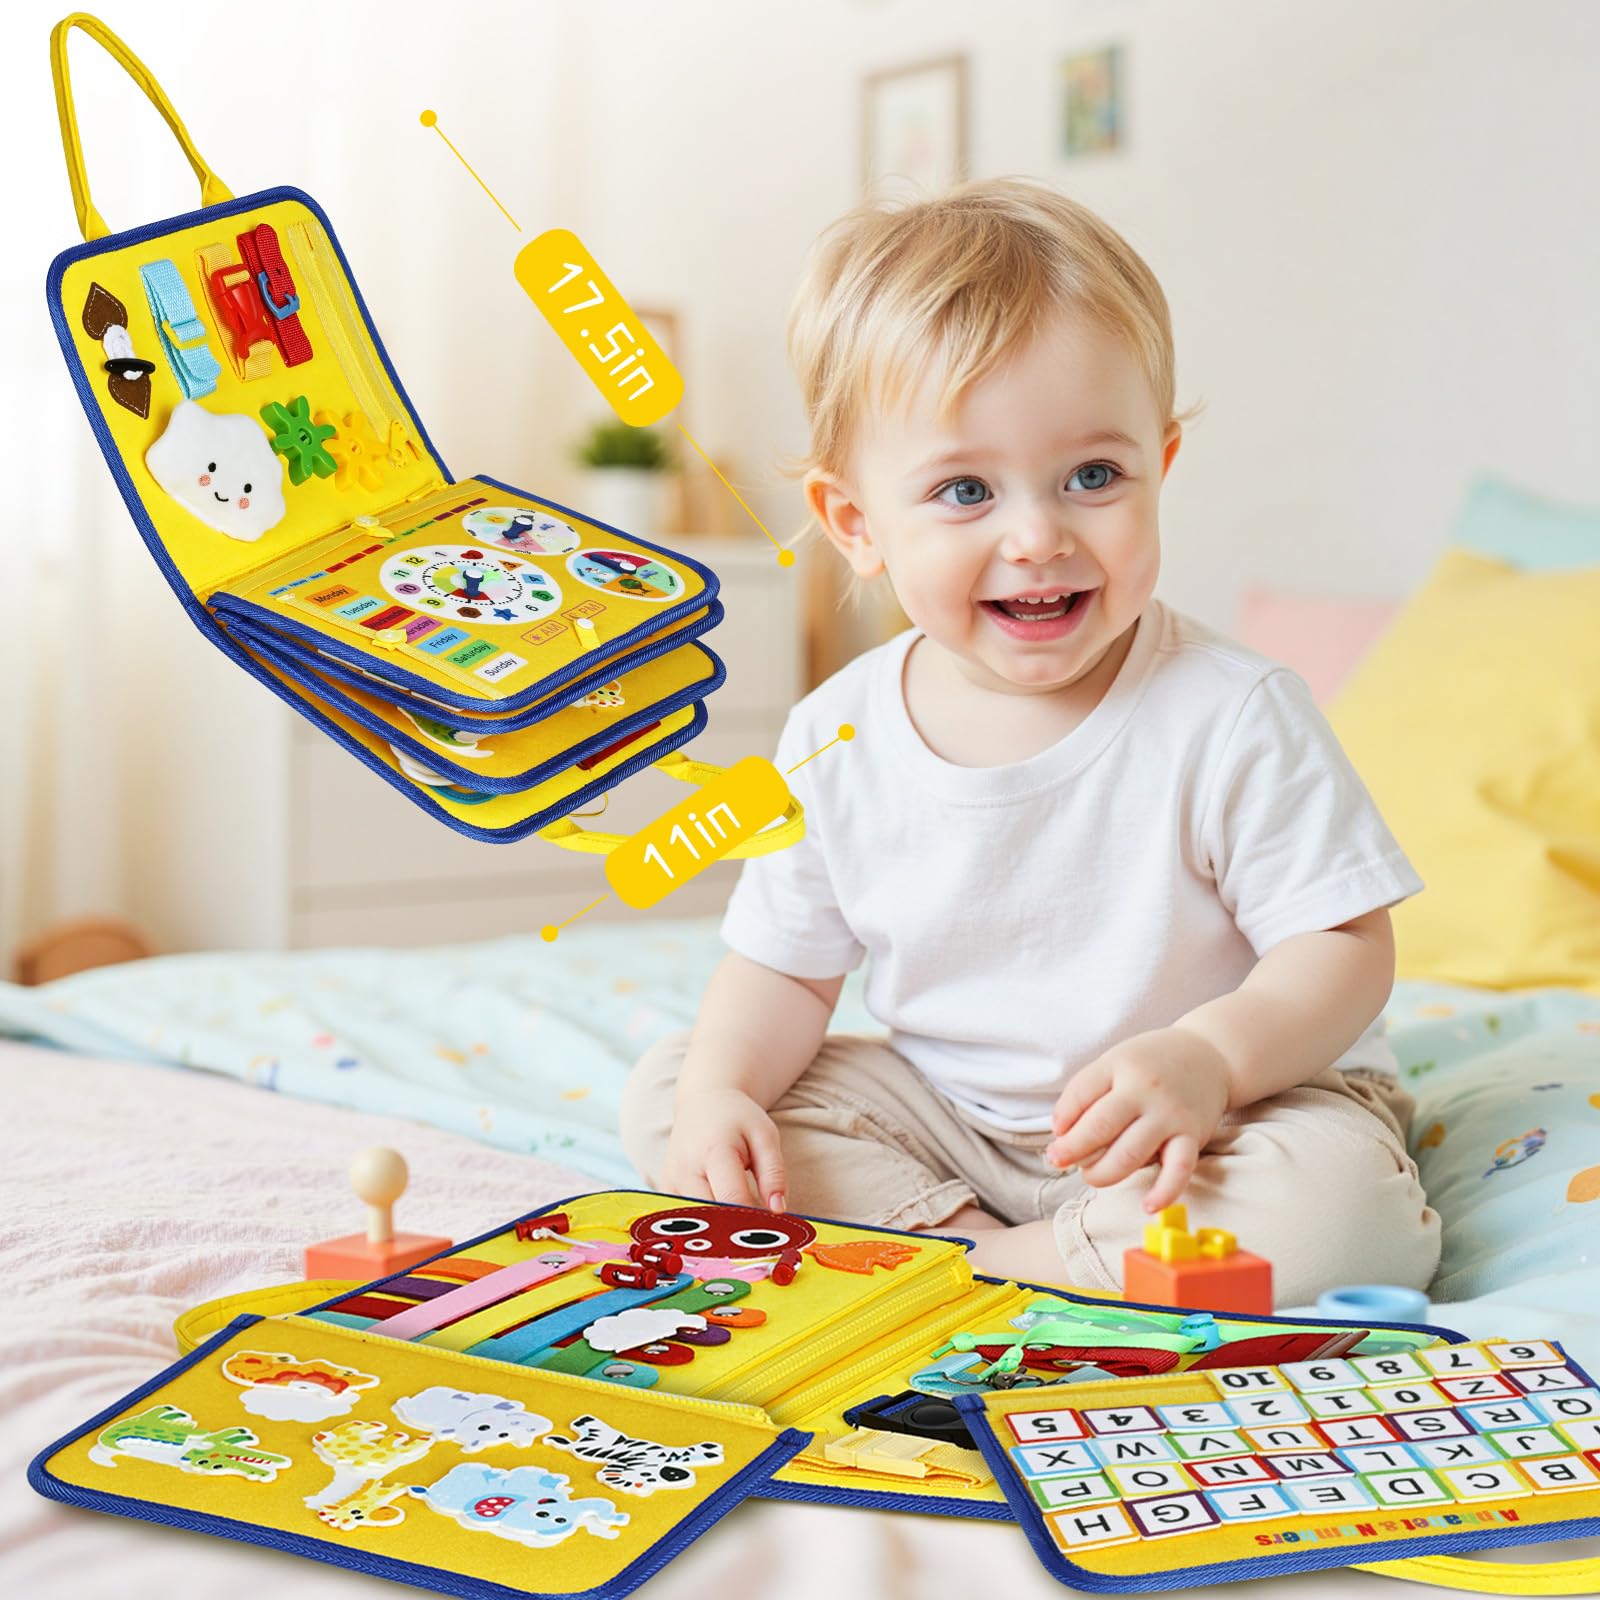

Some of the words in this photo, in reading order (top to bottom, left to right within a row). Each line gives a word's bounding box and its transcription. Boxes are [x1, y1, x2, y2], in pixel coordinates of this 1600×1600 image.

[406, 556, 424, 565] 12
[394, 570, 410, 578] 11
[313, 588, 349, 604] Monday
[400, 584, 417, 594] 10
[535, 590, 549, 599] 5
[341, 599, 378, 616] Tuesday
[525, 604, 539, 612] 6
[578, 603, 600, 615] PM
[540, 623, 561, 637] AM
[429, 632, 459, 649] Friday
[453, 643, 492, 664] Saturday
[484, 658, 518, 677] Sunday
[1510, 1347, 1535, 1358] 6
[1376, 1361, 1402, 1374] 8
[1451, 1354, 1472, 1367] 7
[1222, 1372, 1274, 1387] 10
[1310, 1367, 1335, 1380] 9
[1538, 1374, 1563, 1386] Y
[1462, 1381, 1494, 1394] Z
[1252, 1401, 1280, 1416] 2
[1325, 1396, 1351, 1409] 1
[1553, 1399, 1592, 1415] Q
[1108, 1414, 1132, 1426] 4
[1183, 1410, 1208, 1422] 3
[1485, 1409, 1520, 1422] R
[1032, 1418, 1057, 1433] 5
[1414, 1418, 1445, 1431] S
[1268, 1432, 1301, 1445] U
[1348, 1426, 1373, 1440] T
[1117, 1442, 1156, 1458] W
[1200, 1438, 1229, 1450] V
[1517, 1436, 1535, 1450] J
[1039, 1451, 1074, 1466] X
[1365, 1452, 1396, 1465] L
[1437, 1445, 1473, 1460] K
[1212, 1464, 1248, 1478] N
[1286, 1459, 1323, 1471] M
[1541, 1464, 1576, 1480] B
[1133, 1472, 1168, 1487] O
[1467, 1473, 1499, 1488] C
[1062, 1482, 1091, 1496] P
[1389, 1479, 1424, 1495] D
[1310, 1487, 1345, 1502] E
[1240, 1494, 1266, 1510] F
[1152, 1504, 1189, 1522] G
[1400, 1509, 1519, 1531] Alphabet
[1074, 1515, 1110, 1536] H
[1379, 1520, 1399, 1532] &
[1254, 1523, 1378, 1546] Numbers
